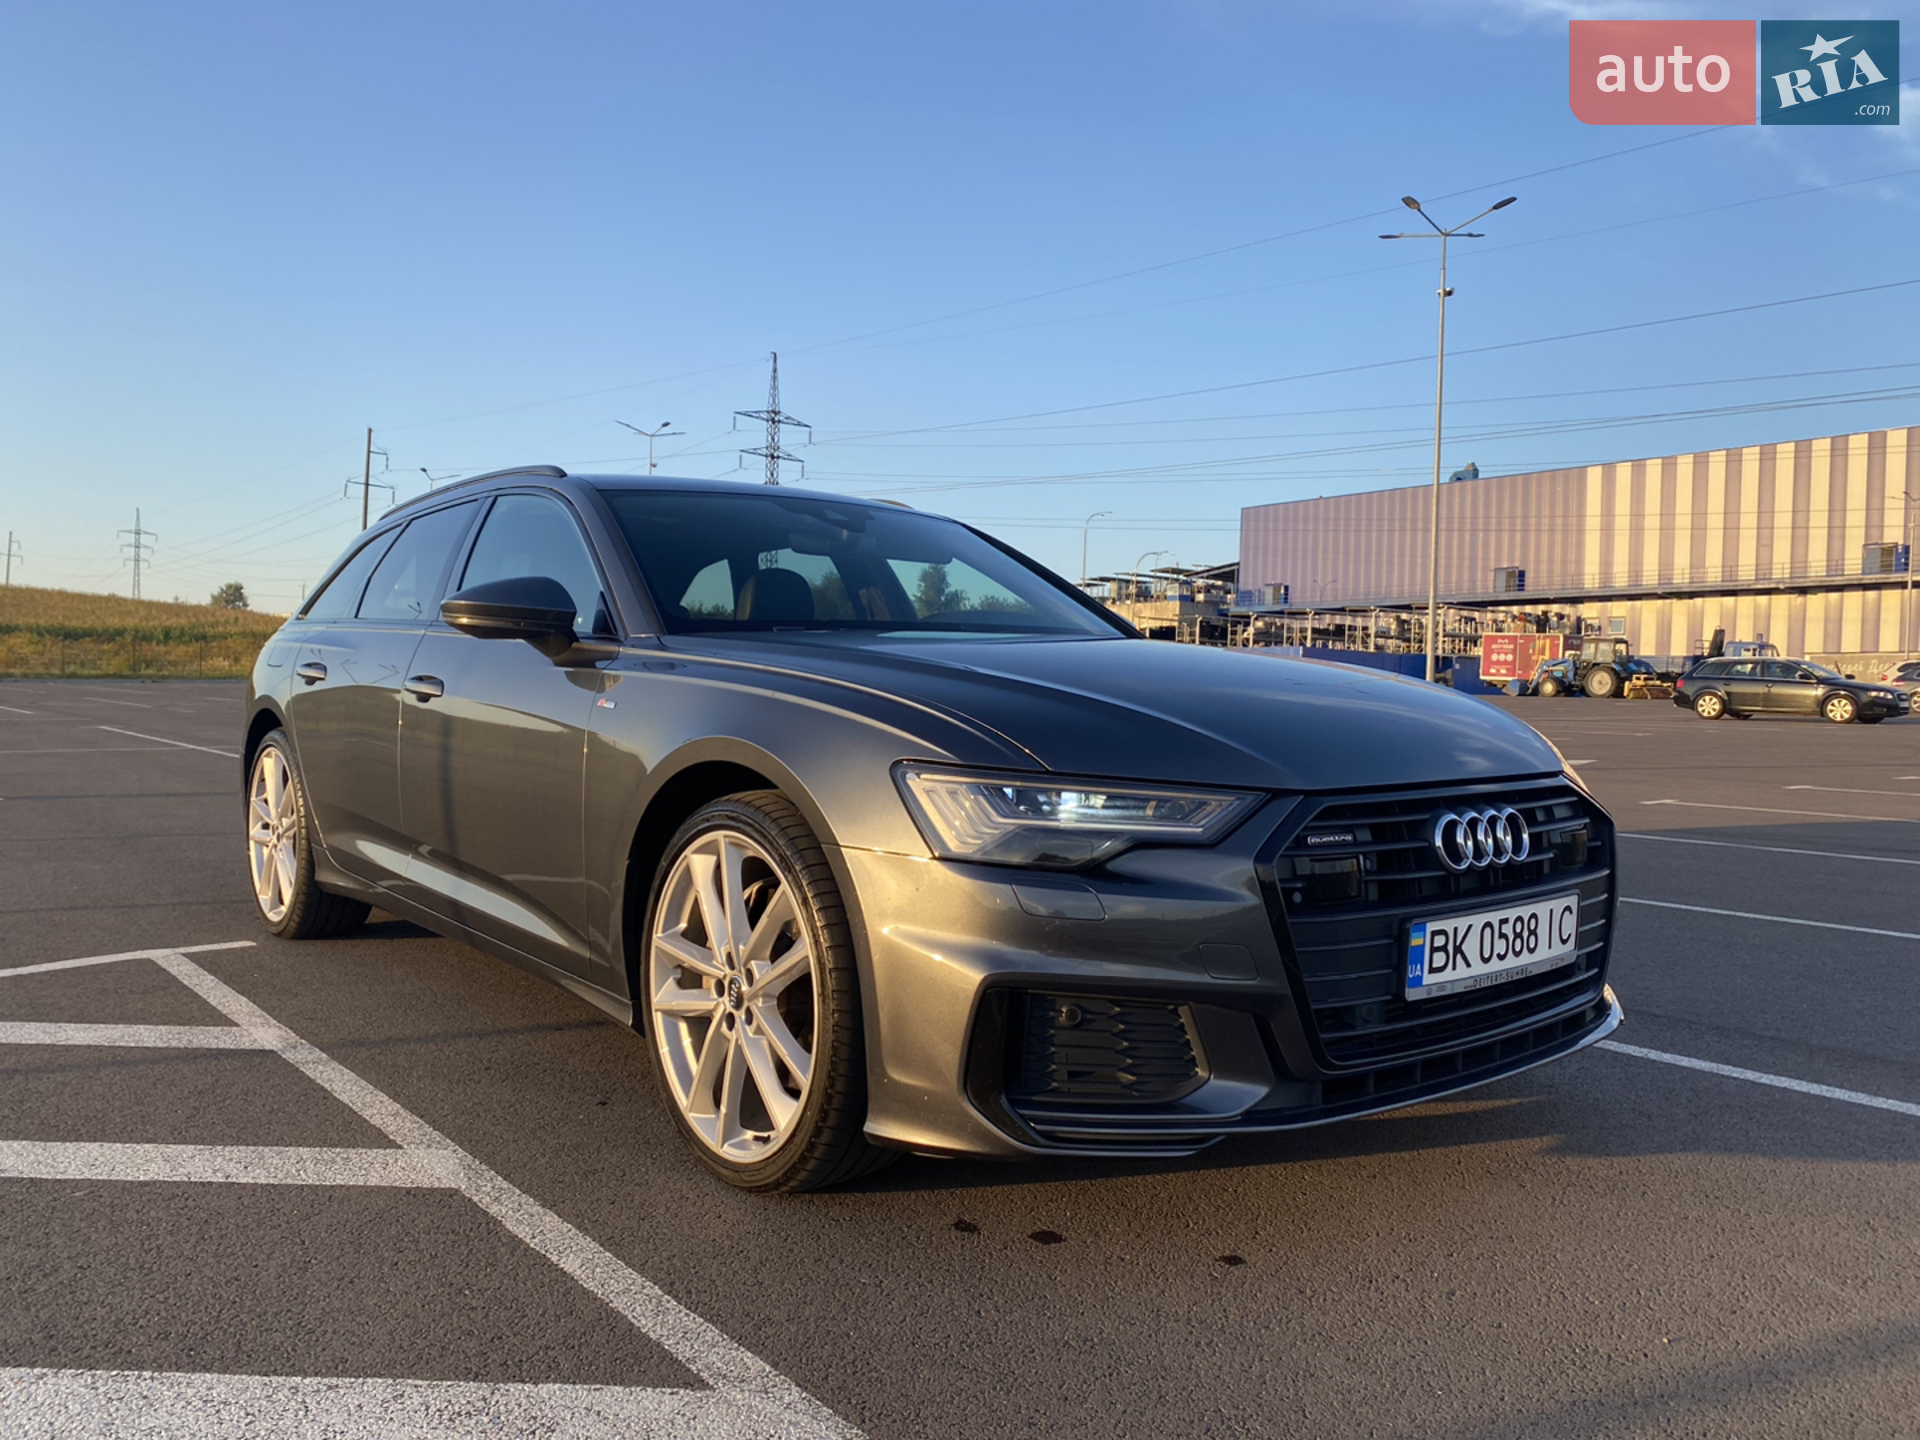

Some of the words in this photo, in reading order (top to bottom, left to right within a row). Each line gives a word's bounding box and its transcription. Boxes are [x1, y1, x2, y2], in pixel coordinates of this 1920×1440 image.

[1427, 923, 1474, 975] BK
[1479, 912, 1539, 964] 0588
[1548, 904, 1574, 950] IC
[1408, 963, 1422, 978] UA
